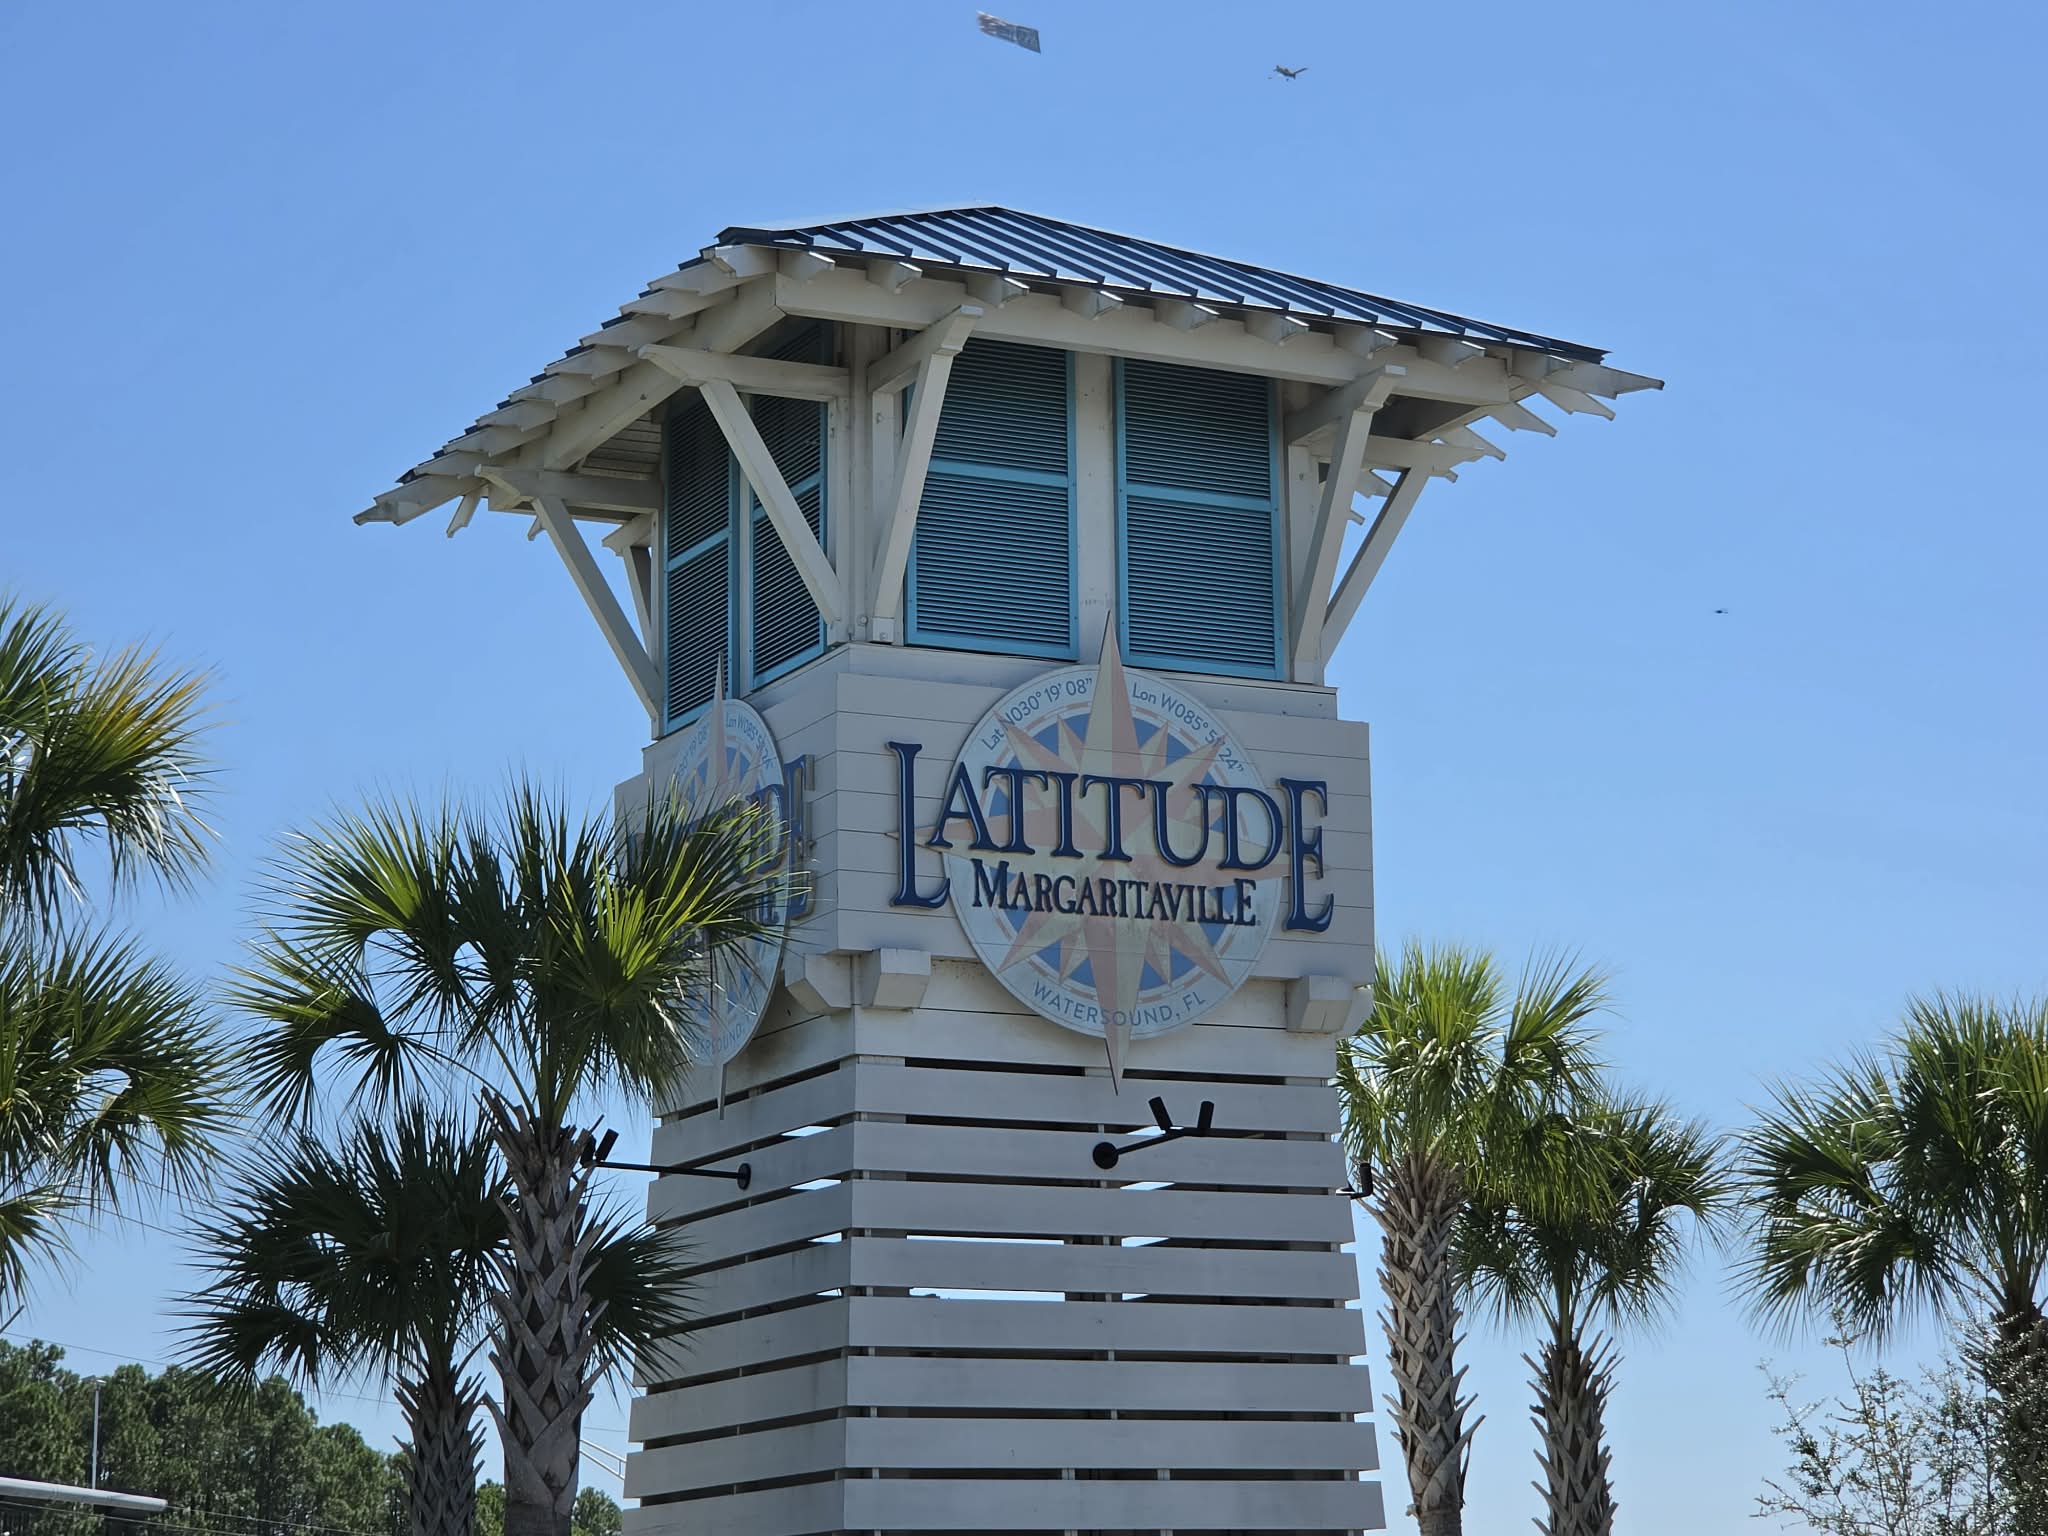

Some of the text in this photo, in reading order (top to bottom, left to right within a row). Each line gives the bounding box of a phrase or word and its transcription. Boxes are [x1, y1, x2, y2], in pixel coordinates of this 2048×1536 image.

[1132, 683, 1157, 705] Lon
[1161, 692, 1209, 731] W085°
[982, 728, 1005, 751] Lat
[888, 740, 1334, 933] LATITUDE
[972, 858, 1258, 927] MARGARITAVILLE
[1033, 980, 1206, 1027] WATERSOUND, FL
